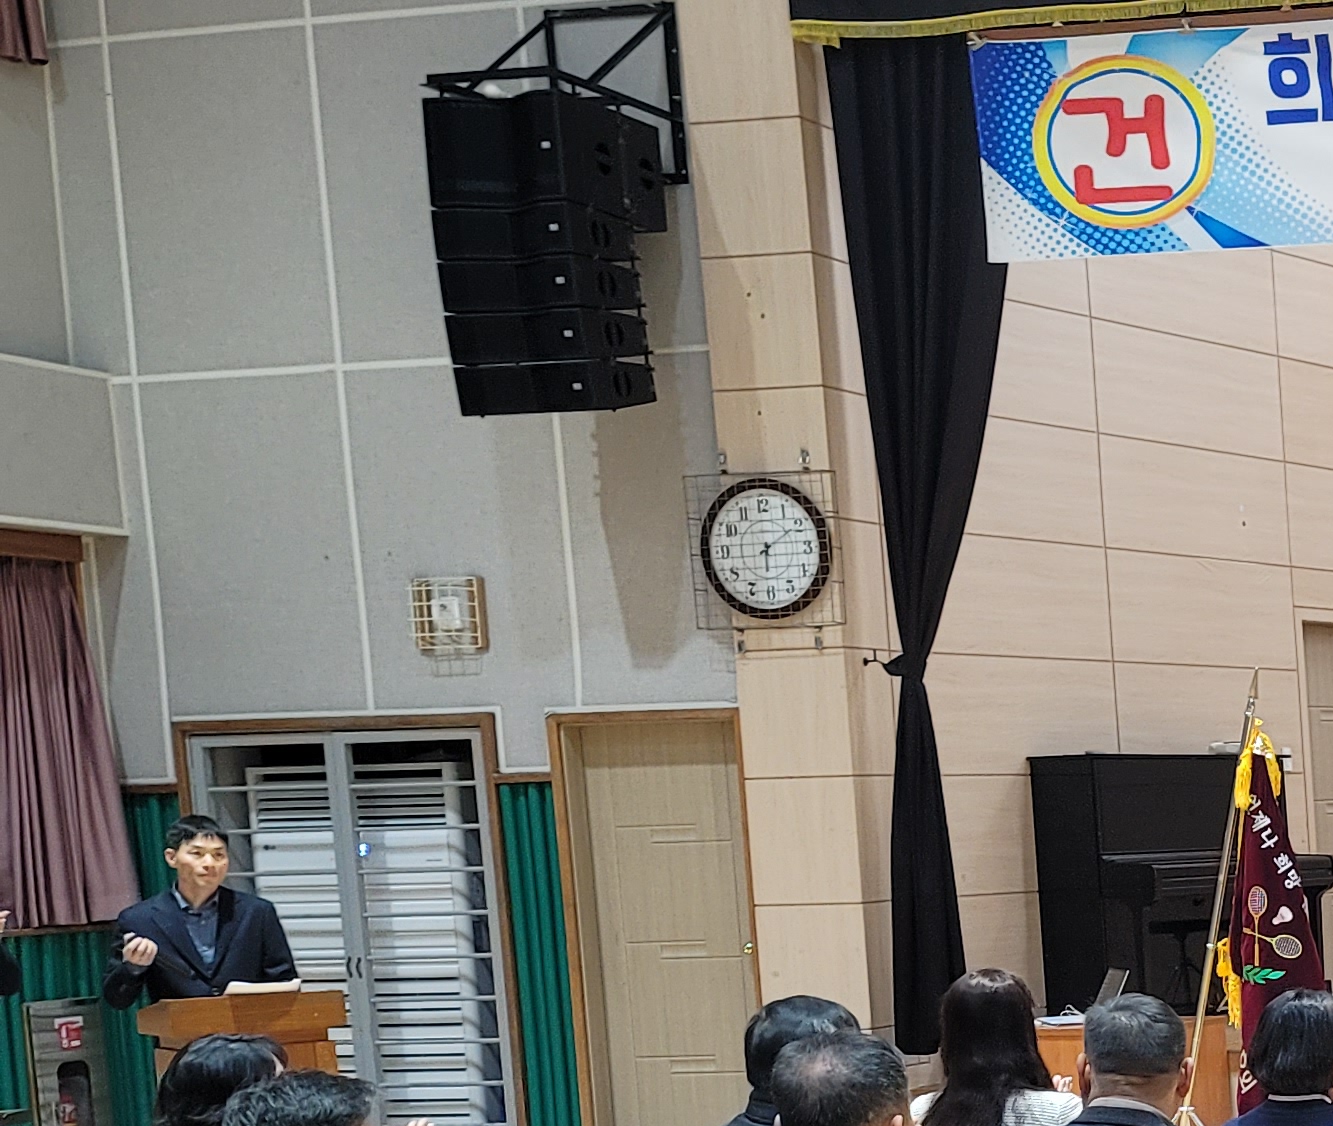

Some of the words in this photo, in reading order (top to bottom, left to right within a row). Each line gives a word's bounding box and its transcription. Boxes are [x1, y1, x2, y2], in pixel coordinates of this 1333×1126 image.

[1061, 94, 1174, 206] 건
[757, 498, 769, 514] 12
[1273, 852, 1302, 890] 희망
